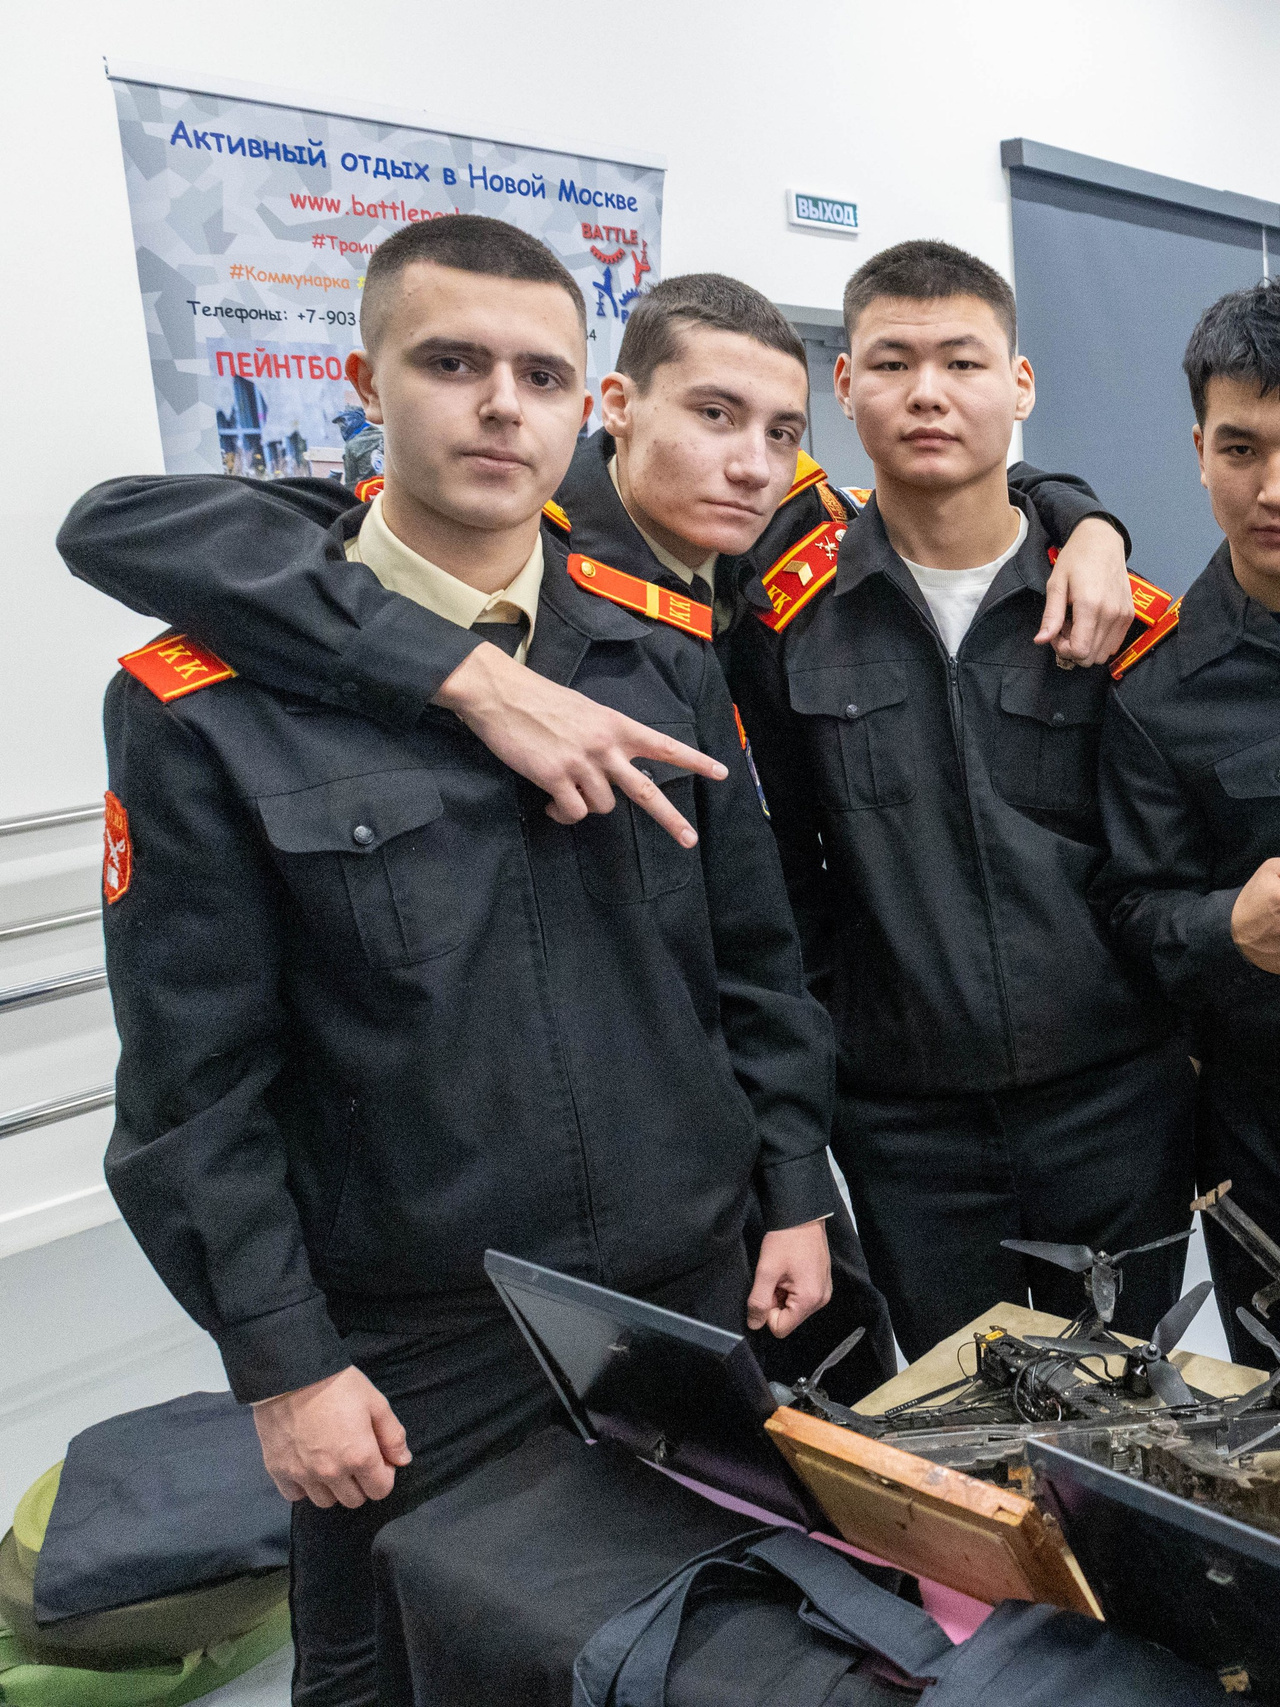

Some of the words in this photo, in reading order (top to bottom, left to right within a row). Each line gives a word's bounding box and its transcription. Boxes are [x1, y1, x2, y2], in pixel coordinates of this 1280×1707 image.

[170, 120, 327, 168] Активный
[341, 152, 430, 183] отдых
[443, 167, 457, 186] в
[468, 163, 546, 199] Новой
[558, 178, 638, 212] Москве
[797, 197, 856, 227] ВЫХОД
[581, 222, 638, 245] BATTLE
[229, 263, 351, 292] #Коммунарка
[186, 300, 289, 323] Телефоны:
[297, 309, 361, 326] +7-903
[215, 347, 349, 381] ПЕЙНТБО
[669, 596, 691, 623] КК
[157, 644, 209, 680] КК
